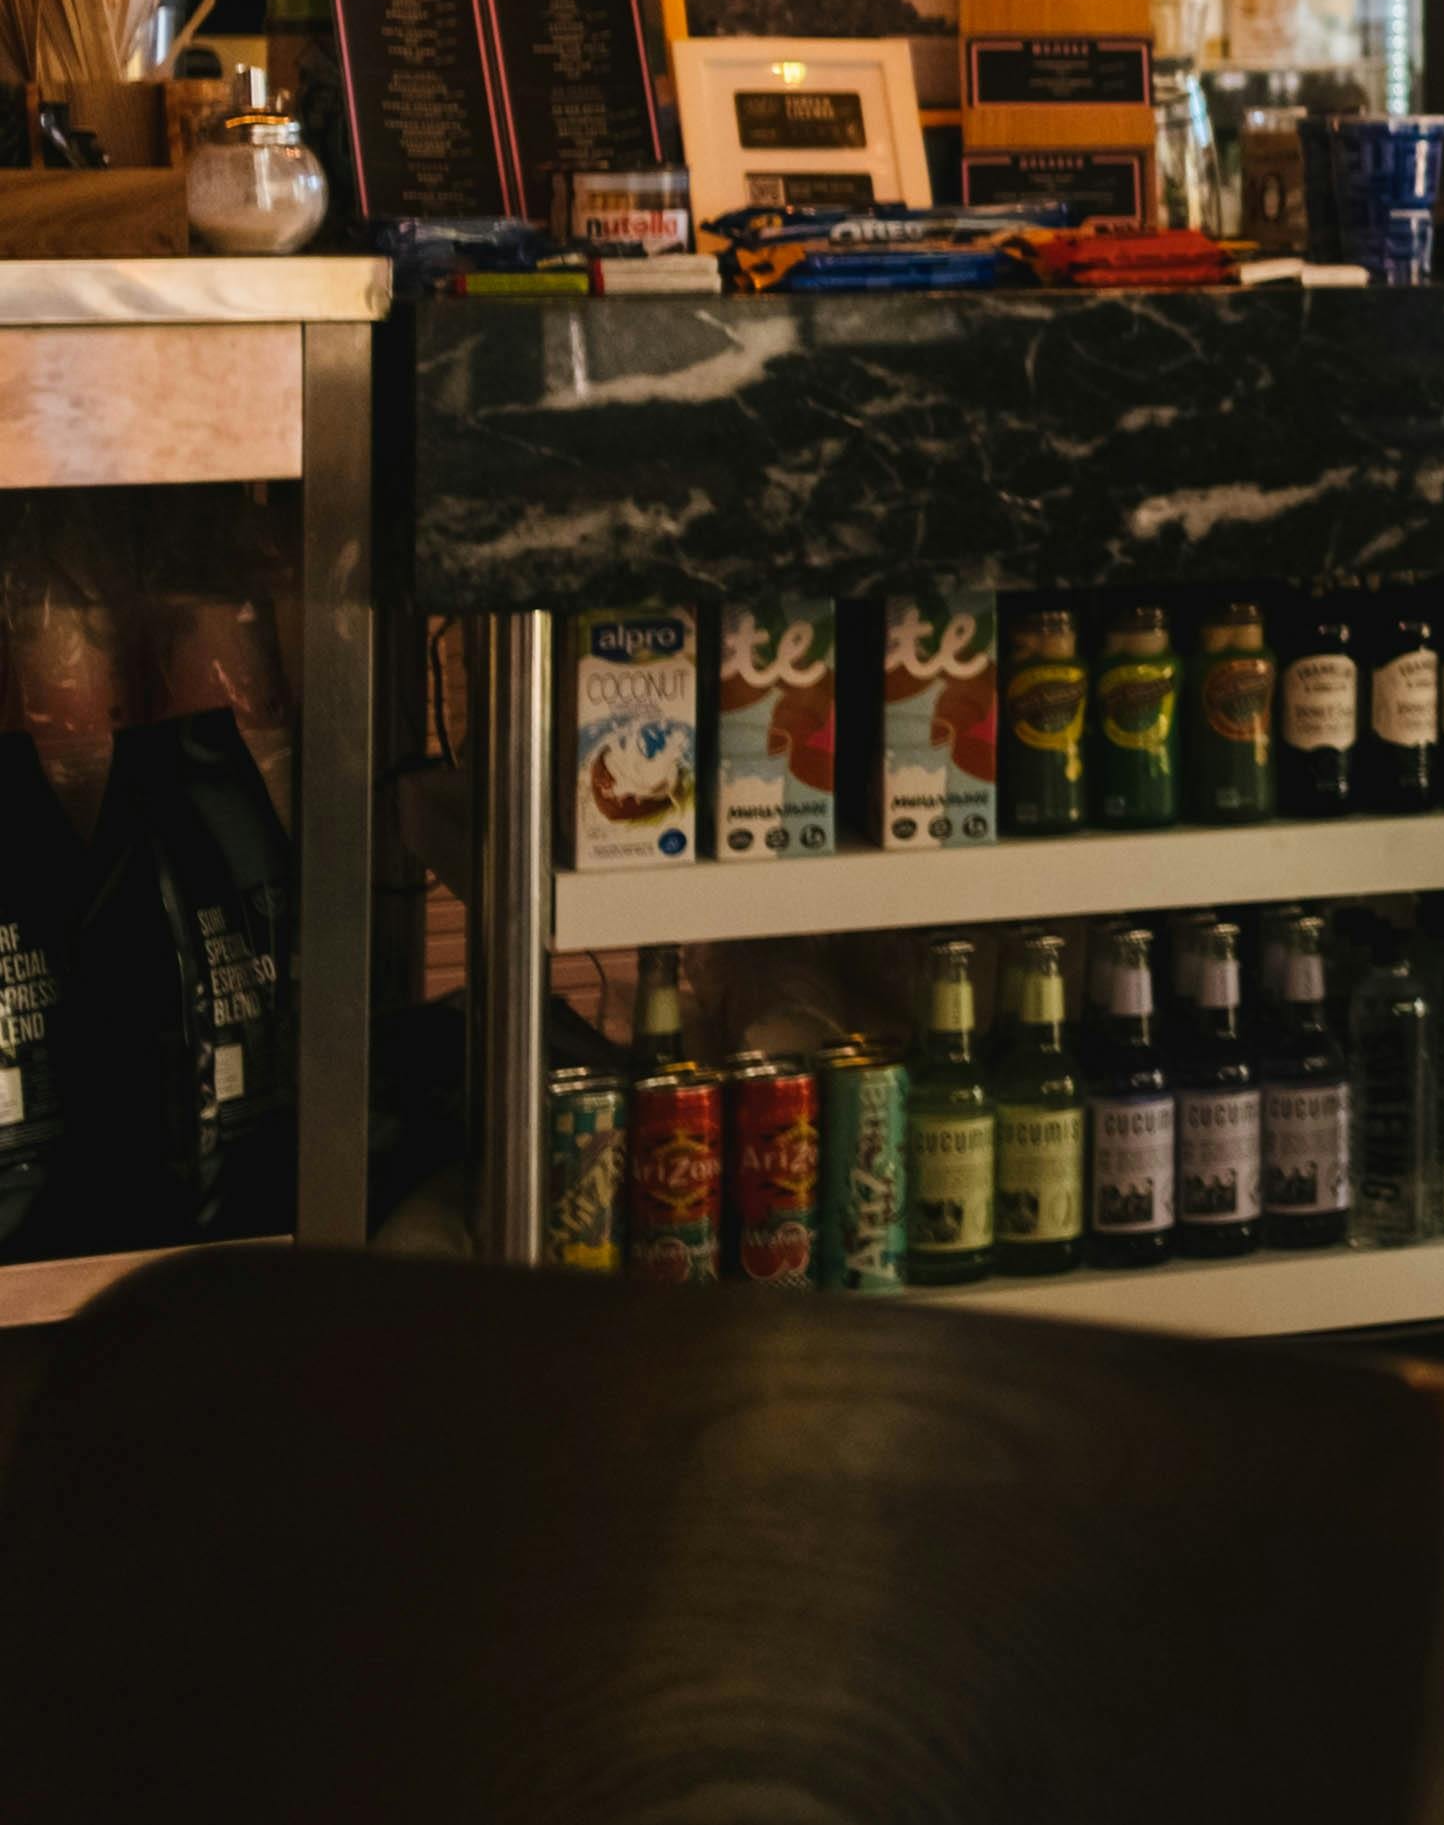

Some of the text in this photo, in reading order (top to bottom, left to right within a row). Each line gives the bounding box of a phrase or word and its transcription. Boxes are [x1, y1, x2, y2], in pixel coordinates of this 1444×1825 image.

[830, 219, 927, 244] OREO
[599, 624, 677, 656] alpro
[586, 670, 690, 704] COCONUT
[0, 948, 48, 984] ECIAL
[0, 1010, 46, 1047] LEND
[1104, 1107, 1173, 1136] CUCUM
[1188, 1102, 1260, 1129] CUCUM
[1270, 1094, 1339, 1120] CUCUM
